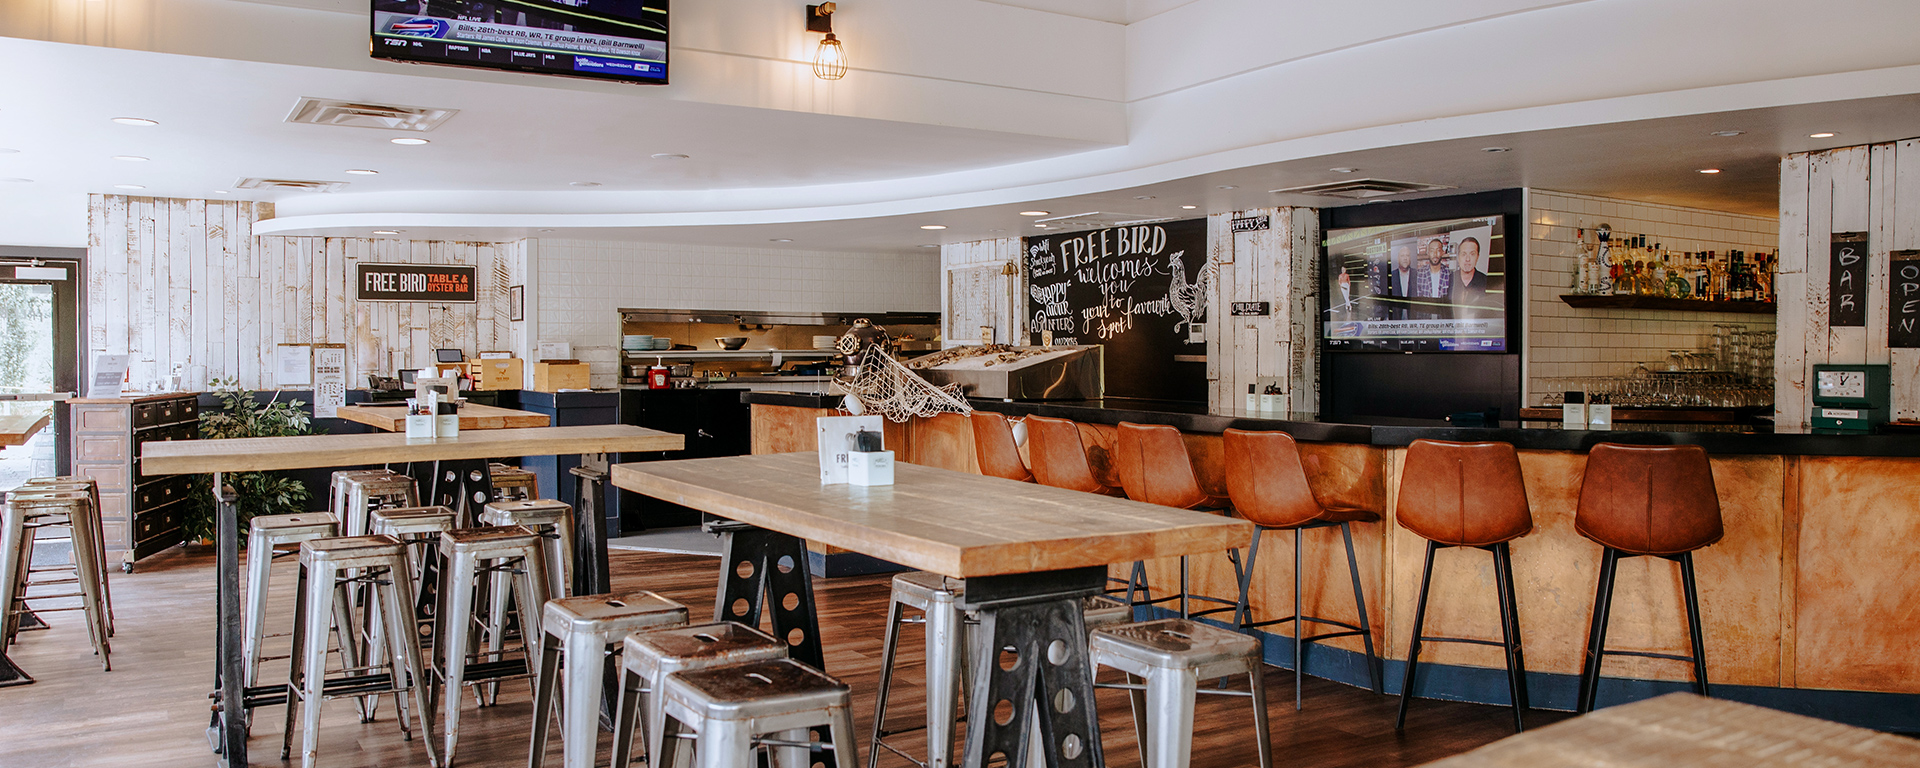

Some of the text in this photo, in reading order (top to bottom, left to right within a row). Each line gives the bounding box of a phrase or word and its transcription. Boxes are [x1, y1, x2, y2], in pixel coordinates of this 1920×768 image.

[384, 38, 407, 46] TSN
[478, 27, 514, 36] 28th-best
[555, 35, 575, 43] group
[613, 40, 645, 50] Barnwell)
[1060, 226, 1167, 274] FREE BIRD
[365, 272, 426, 292] FREE BIRD
[427, 274, 468, 283] TABLE &
[1074, 257, 1159, 284] welcomes
[1838, 247, 1860, 312] BAR
[427, 283, 468, 292] OYSTER BAR
[1098, 280, 1136, 308] you
[1109, 295, 1125, 309] to
[1898, 265, 1920, 334] OPEN
